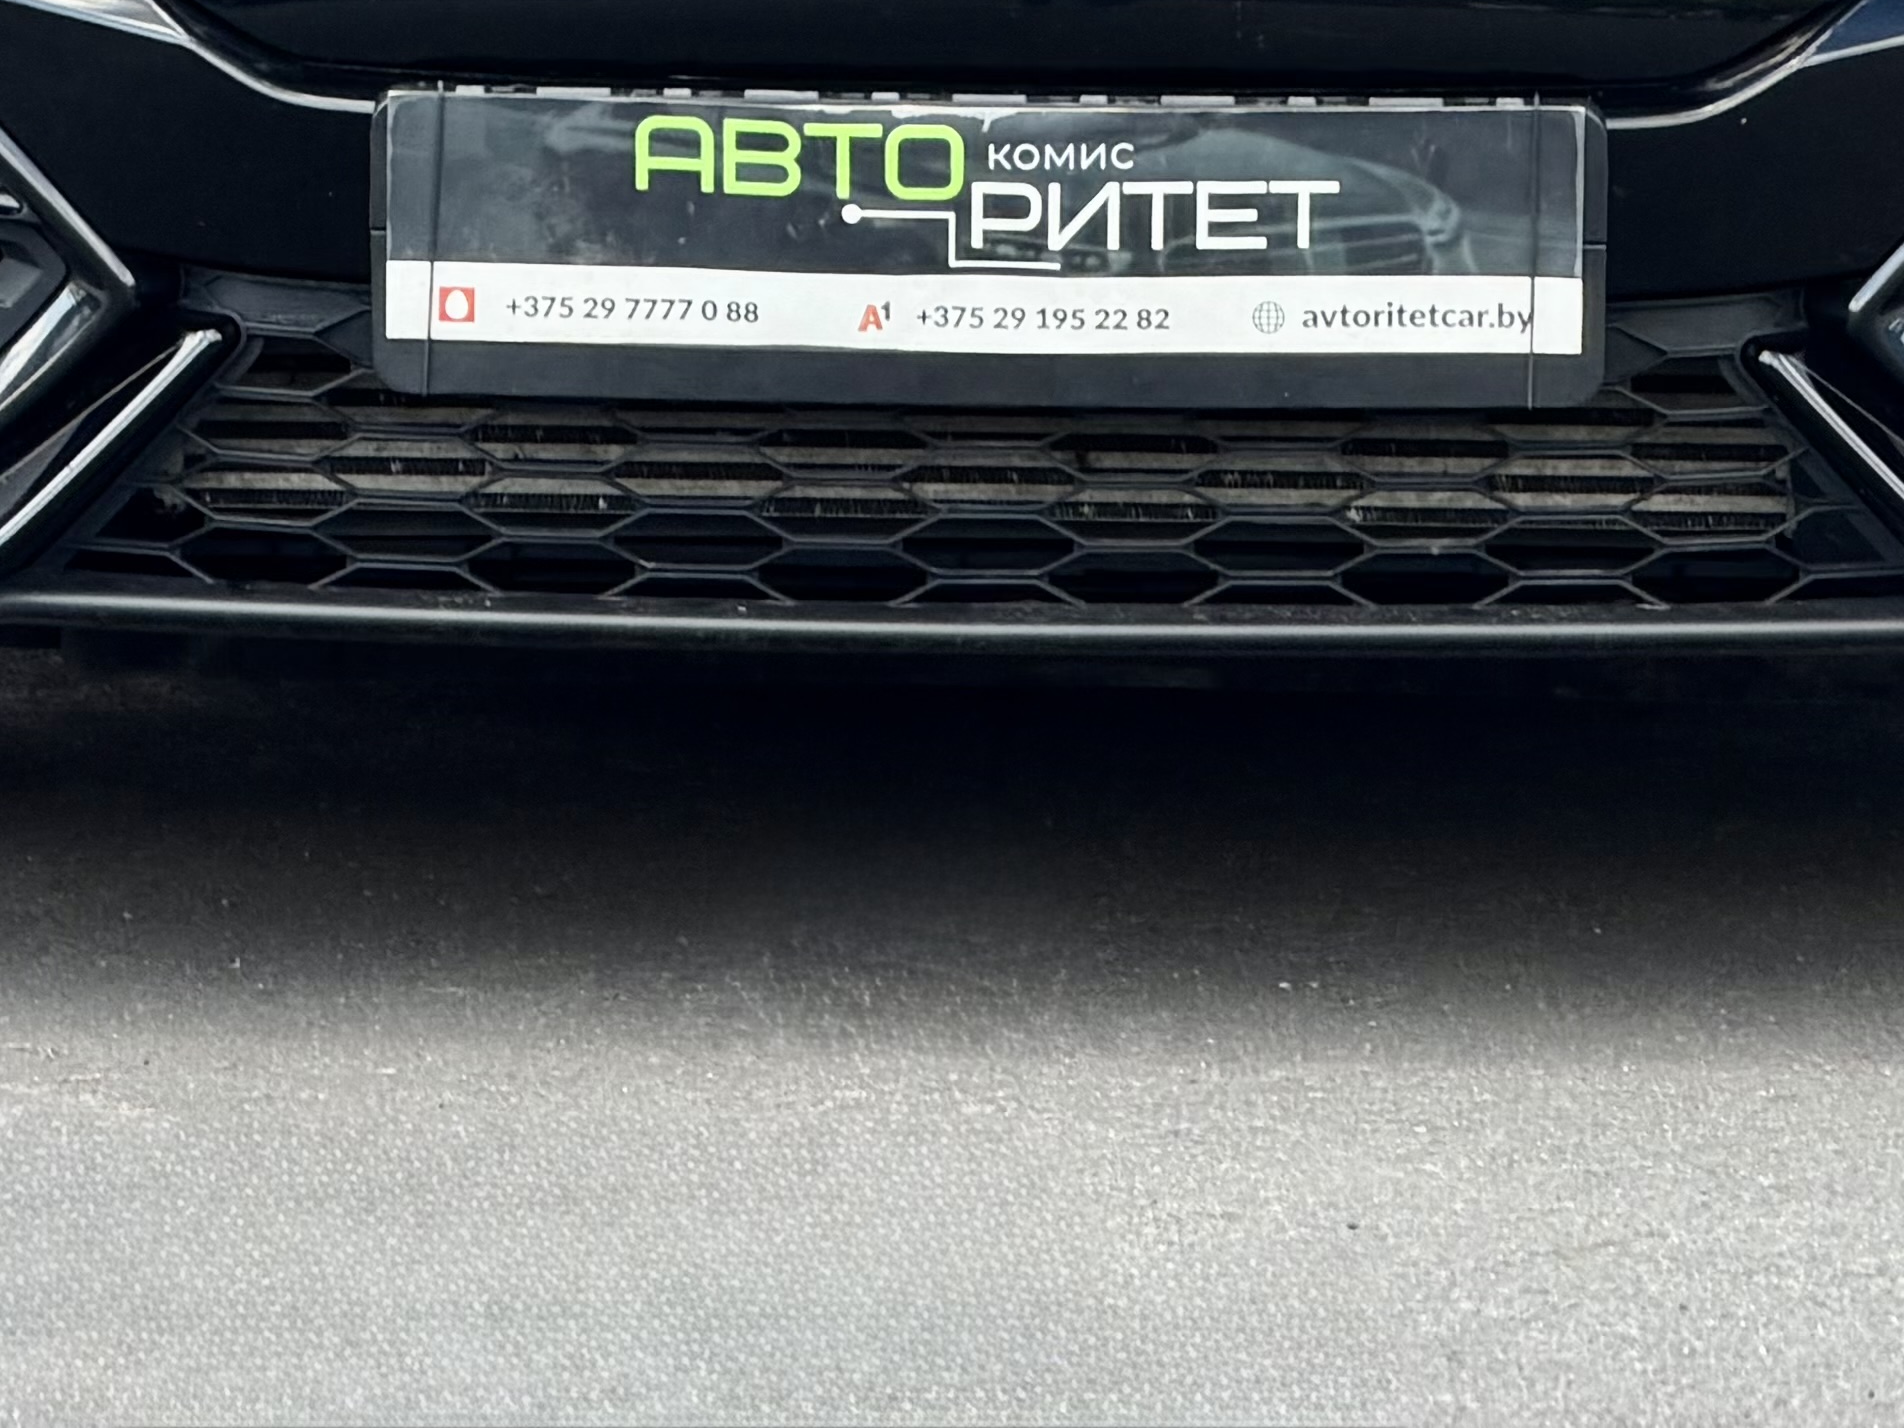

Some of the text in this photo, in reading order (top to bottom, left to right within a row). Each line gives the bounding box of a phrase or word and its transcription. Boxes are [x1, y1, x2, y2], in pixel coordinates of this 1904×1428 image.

[634, 115, 965, 200] АВТО
[971, 181, 1341, 250] РИТЕТ
[506, 295, 760, 323] +375 29 7777 0 88
[916, 305, 1170, 331] +375 29 195 22 82
[1302, 302, 1532, 334] avtoritetcar.by
